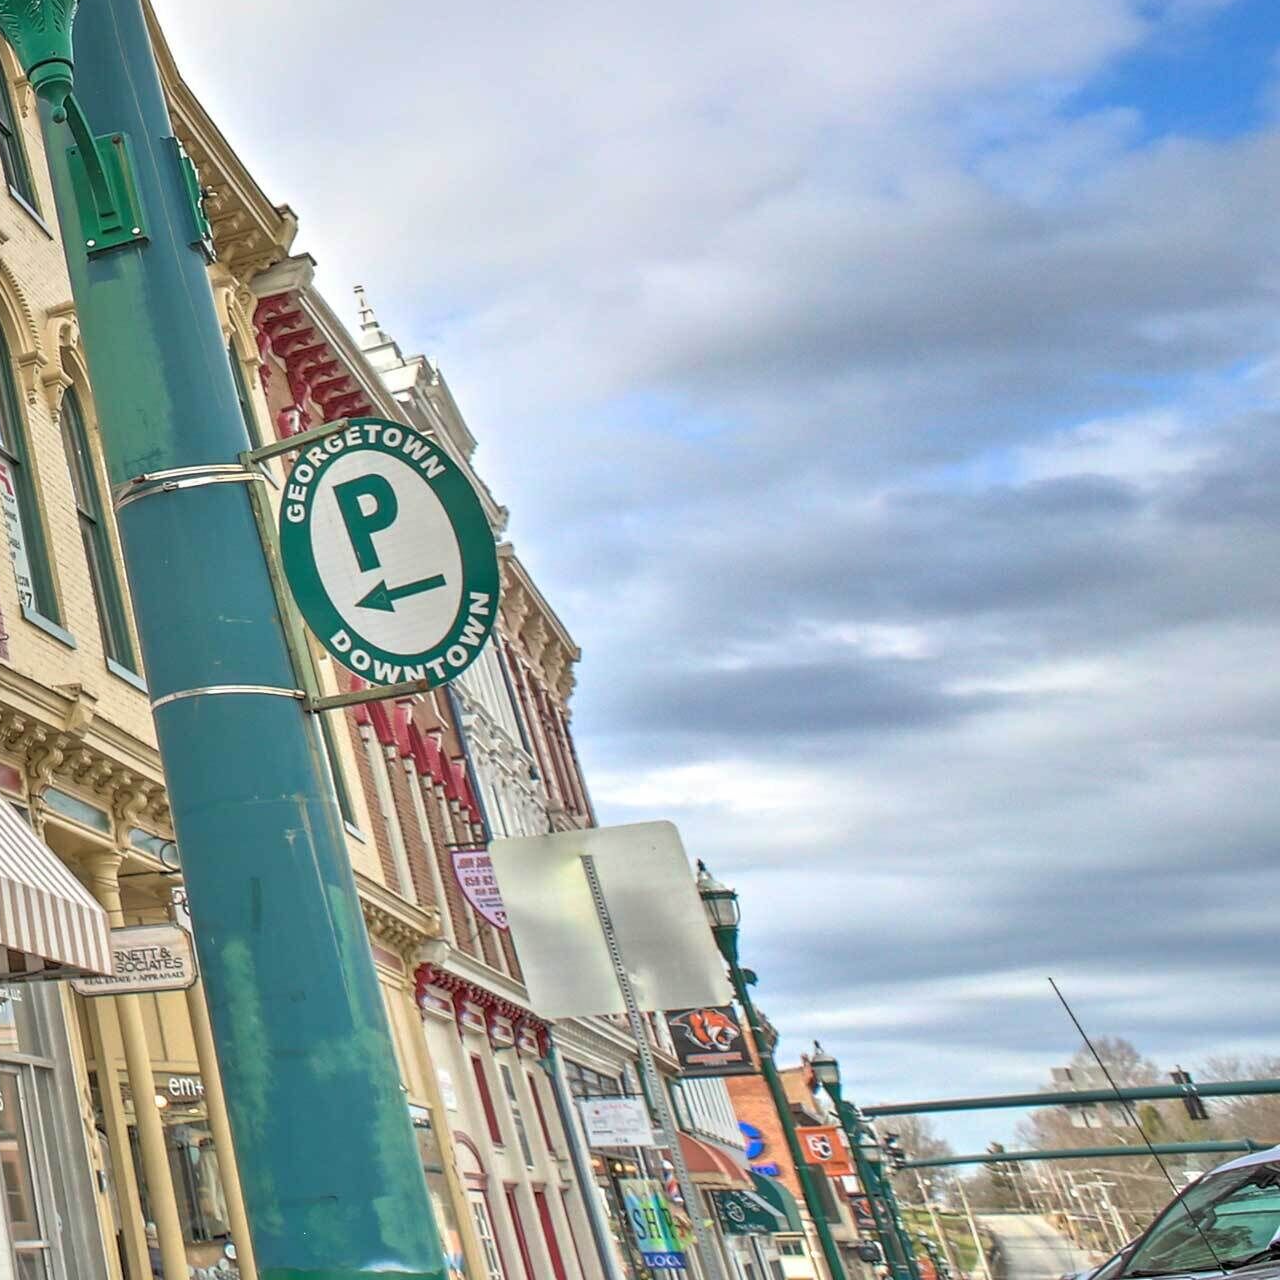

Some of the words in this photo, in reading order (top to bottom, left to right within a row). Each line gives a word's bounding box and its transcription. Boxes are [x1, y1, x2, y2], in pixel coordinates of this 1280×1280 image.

[287, 424, 447, 523] GEORGETOWN
[333, 473, 398, 572] P
[330, 591, 490, 683] DOWNTOWN
[113, 948, 157, 961] RNETT
[160, 947, 171, 959] &
[116, 957, 183, 973] SOCIATES
